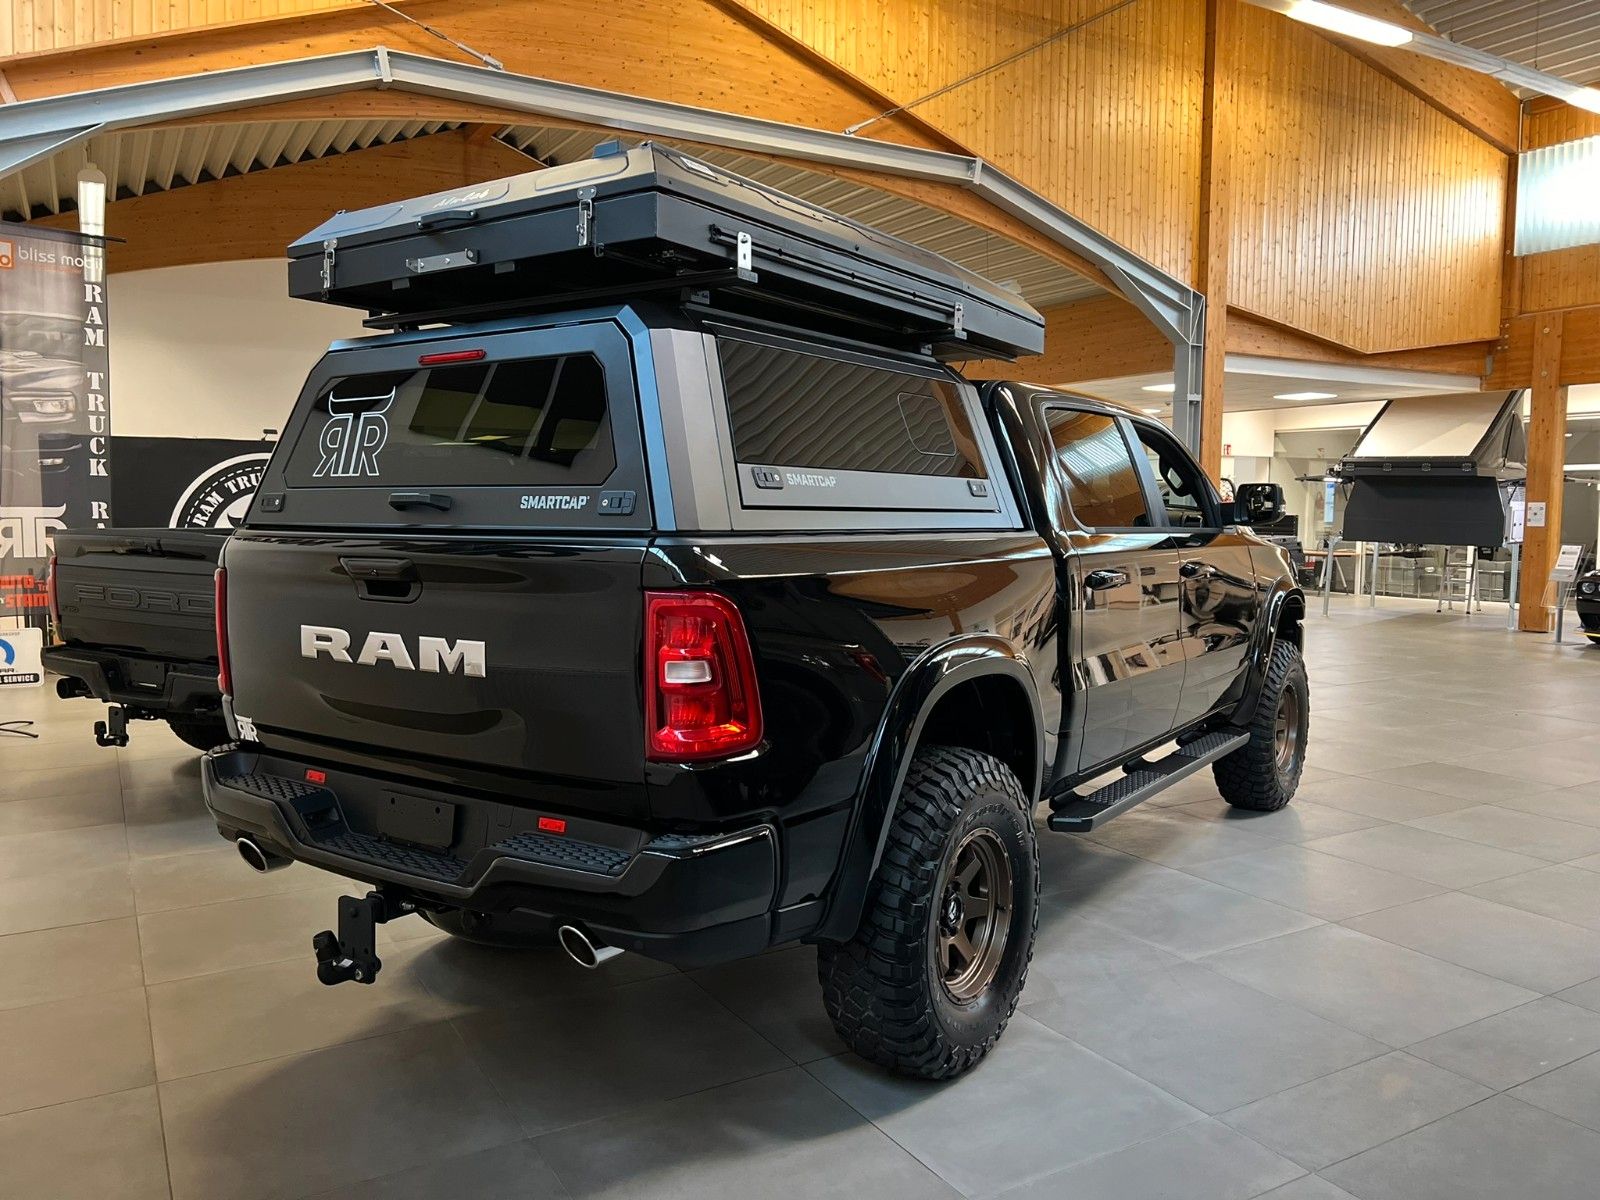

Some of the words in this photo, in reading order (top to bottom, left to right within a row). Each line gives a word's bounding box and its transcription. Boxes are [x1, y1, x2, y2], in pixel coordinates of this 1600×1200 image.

[18, 245, 56, 264] bliss
[83, 283, 105, 347] RAM
[86, 371, 109, 477] TRUCK
[785, 473, 837, 488] SMARTCAP
[192, 490, 225, 527] RAM
[224, 472, 262, 494] TRU
[520, 495, 588, 509] SMARTCAP
[73, 583, 216, 612] FORD
[300, 624, 486, 678] RAM
[3, 674, 34, 683] SERVICE
